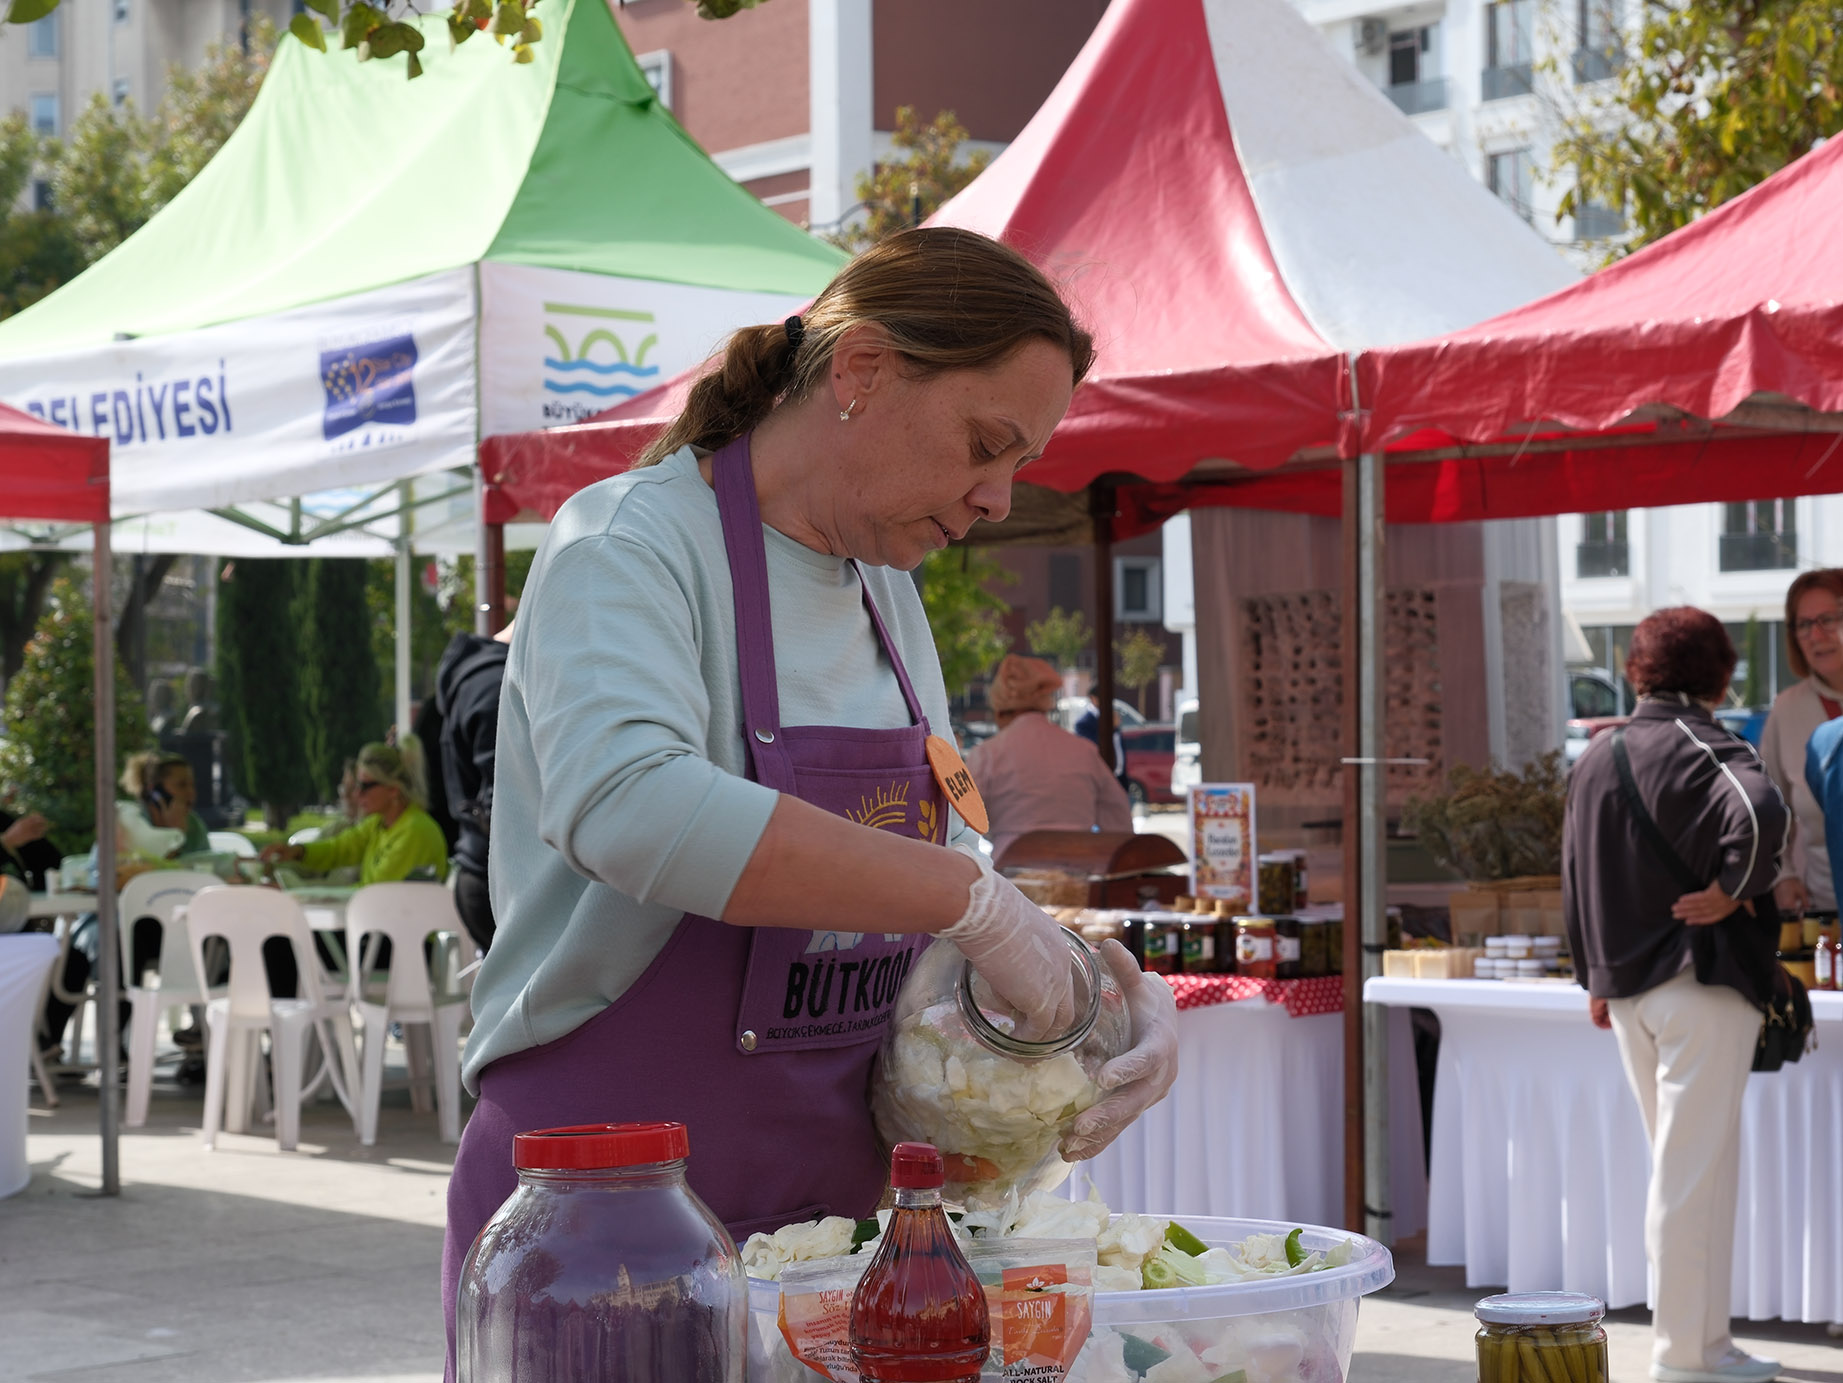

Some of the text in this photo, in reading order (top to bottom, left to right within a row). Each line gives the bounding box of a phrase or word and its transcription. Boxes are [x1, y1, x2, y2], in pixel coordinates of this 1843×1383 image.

[819, 1289, 844, 1304] SAYGIN
[822, 1303, 841, 1315] Söz
[1017, 1300, 1052, 1319] SAYGIN
[1002, 1365, 1064, 1378] ALL-NATURAL
